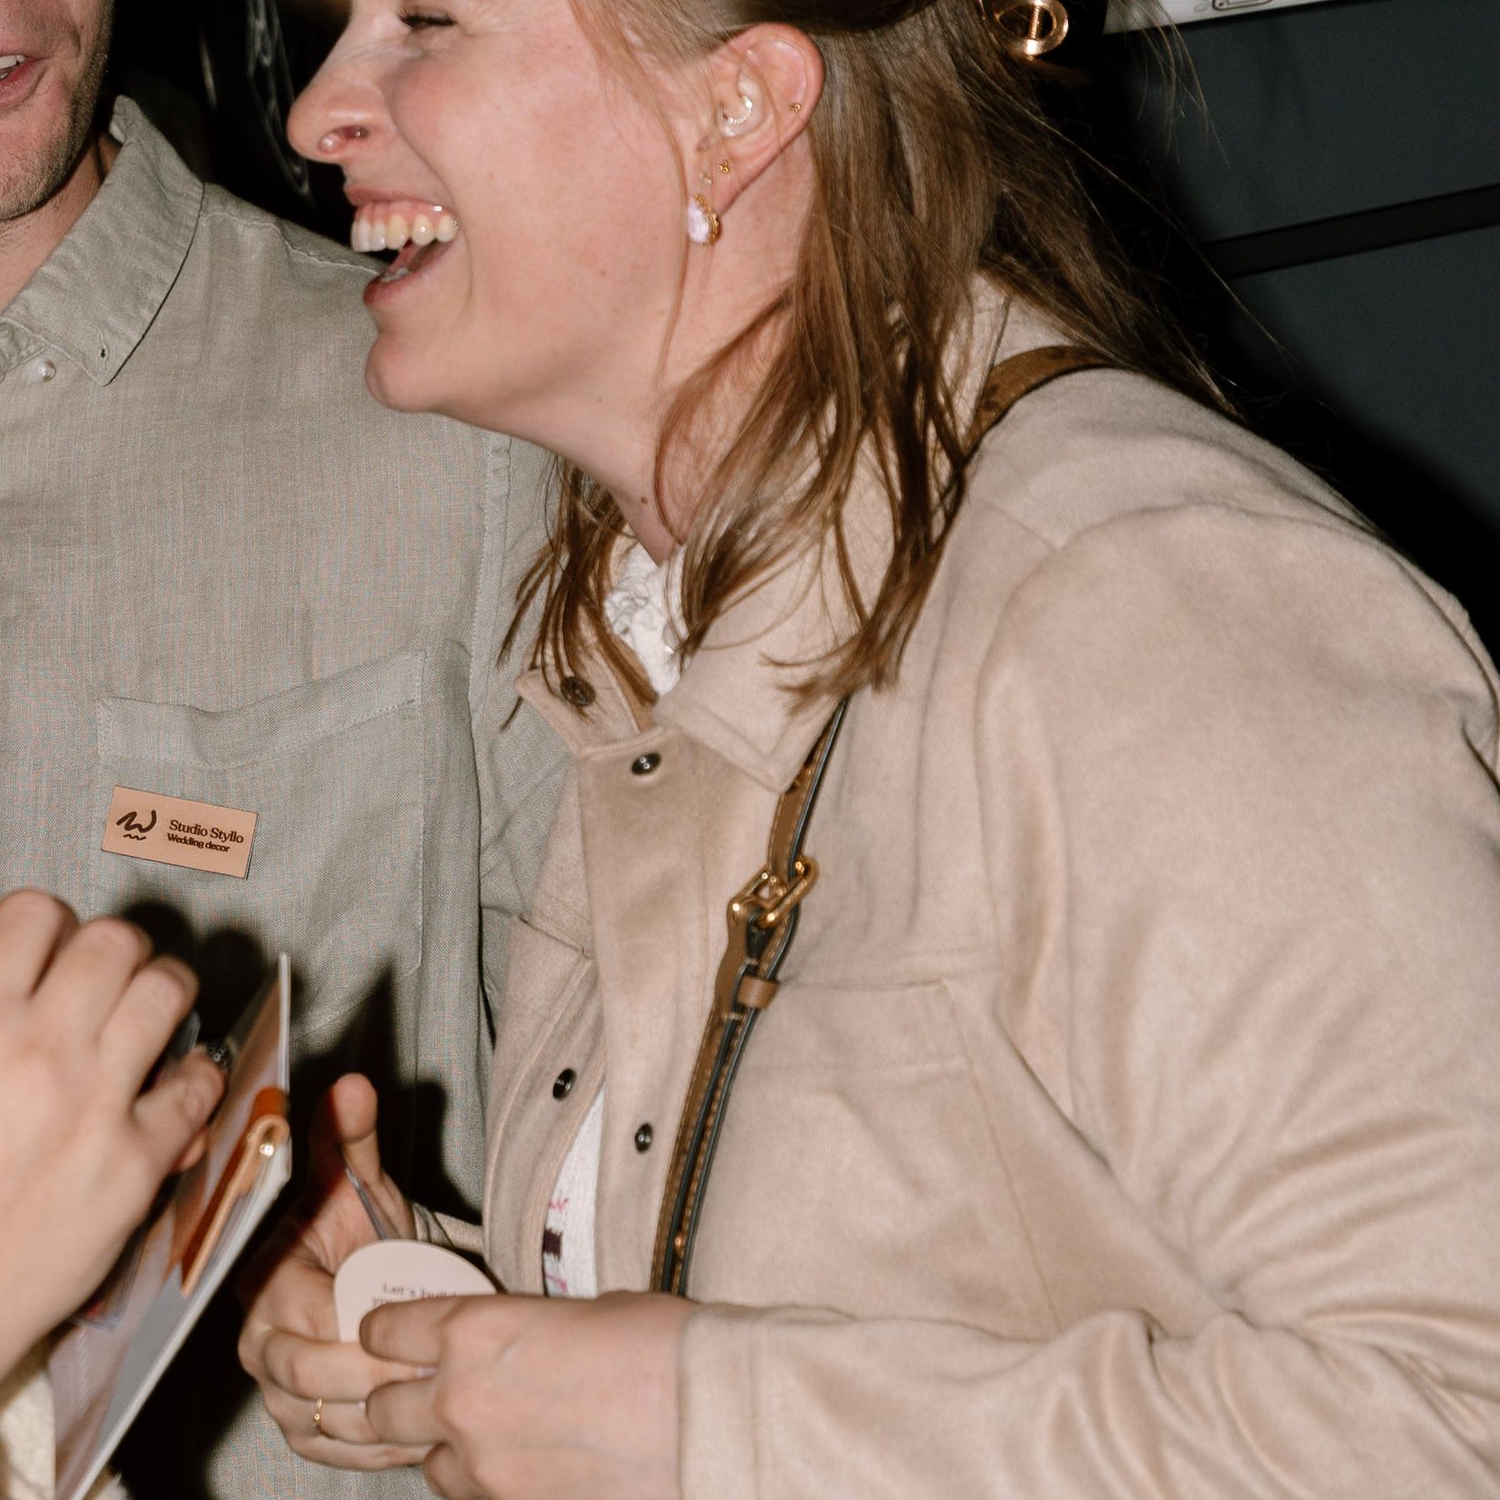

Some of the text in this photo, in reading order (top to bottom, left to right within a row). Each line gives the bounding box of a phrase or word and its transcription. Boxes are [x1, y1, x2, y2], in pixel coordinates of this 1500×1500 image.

[167, 832, 231, 852] Wedding decor
[169, 819, 244, 843] Studio Styllo
